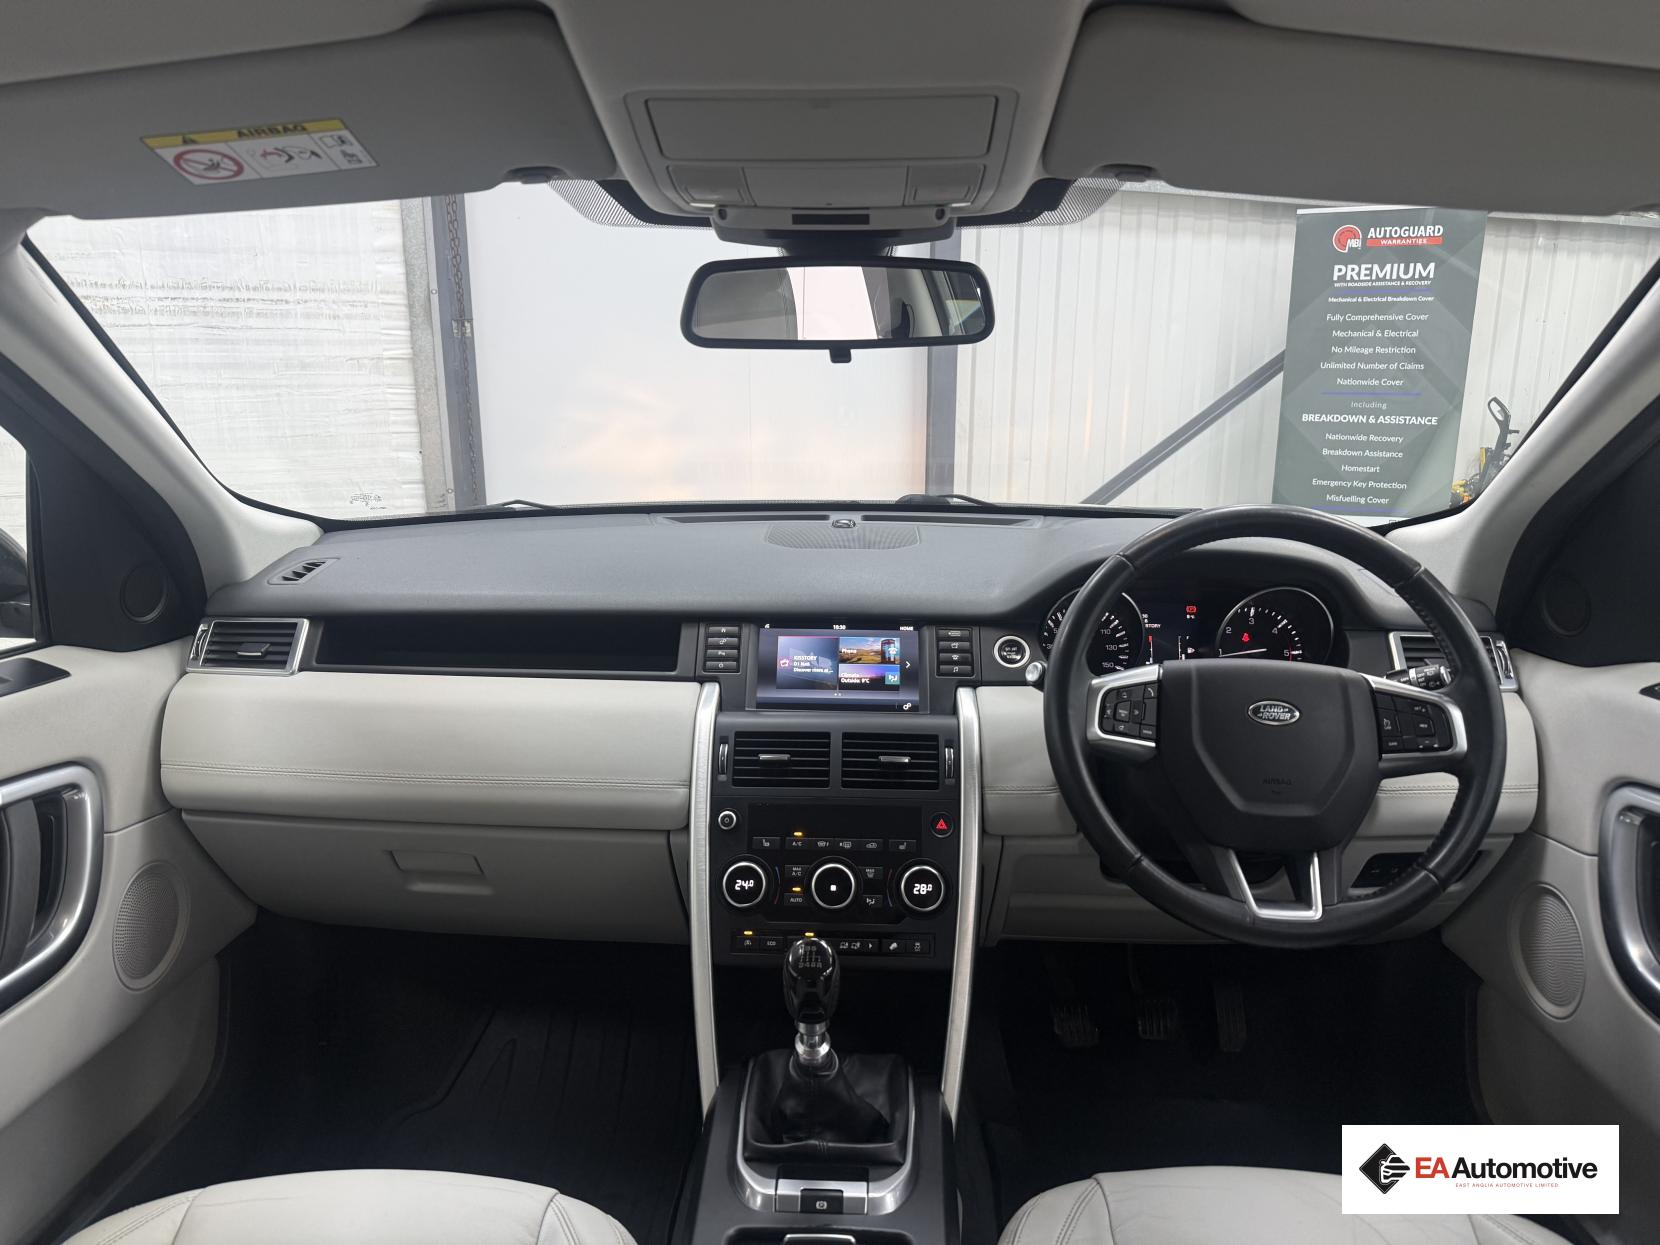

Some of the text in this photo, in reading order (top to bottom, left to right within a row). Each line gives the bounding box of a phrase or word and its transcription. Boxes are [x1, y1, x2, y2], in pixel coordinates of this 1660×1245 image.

[236, 123, 308, 139] AIRBAG
[1367, 225, 1444, 239] AUTOGUARD
[1380, 238, 1428, 246] WARRANTIES
[1332, 262, 1436, 281] PREMIUM
[1326, 313, 1430, 323] Fully Comprehensive Cover
[1332, 329, 1375, 337] Mechanical
[1384, 329, 1419, 337] Electrical
[1344, 346, 1374, 355] Mileage
[1375, 345, 1416, 354] Restriction
[1320, 361, 1425, 370] Unlimited Number of Claims
[1336, 377, 1404, 386] Nationwide Cover
[1350, 401, 1388, 410] Including
[1301, 413, 1438, 426] BREAKDOWN & ASSISTANCE
[1325, 432, 1404, 444] Nationwide Recovery
[1322, 448, 1404, 458] Breakdown Assistance
[1341, 464, 1380, 473] Homestart
[1312, 478, 1407, 490] Emergency Key Protection
[1326, 494, 1390, 505] Misfuelling Cover
[1248, 617, 1255, 625] 3
[1225, 626, 1232, 634] 2
[1271, 627, 1278, 635] 4
[1283, 649, 1290, 657] 5
